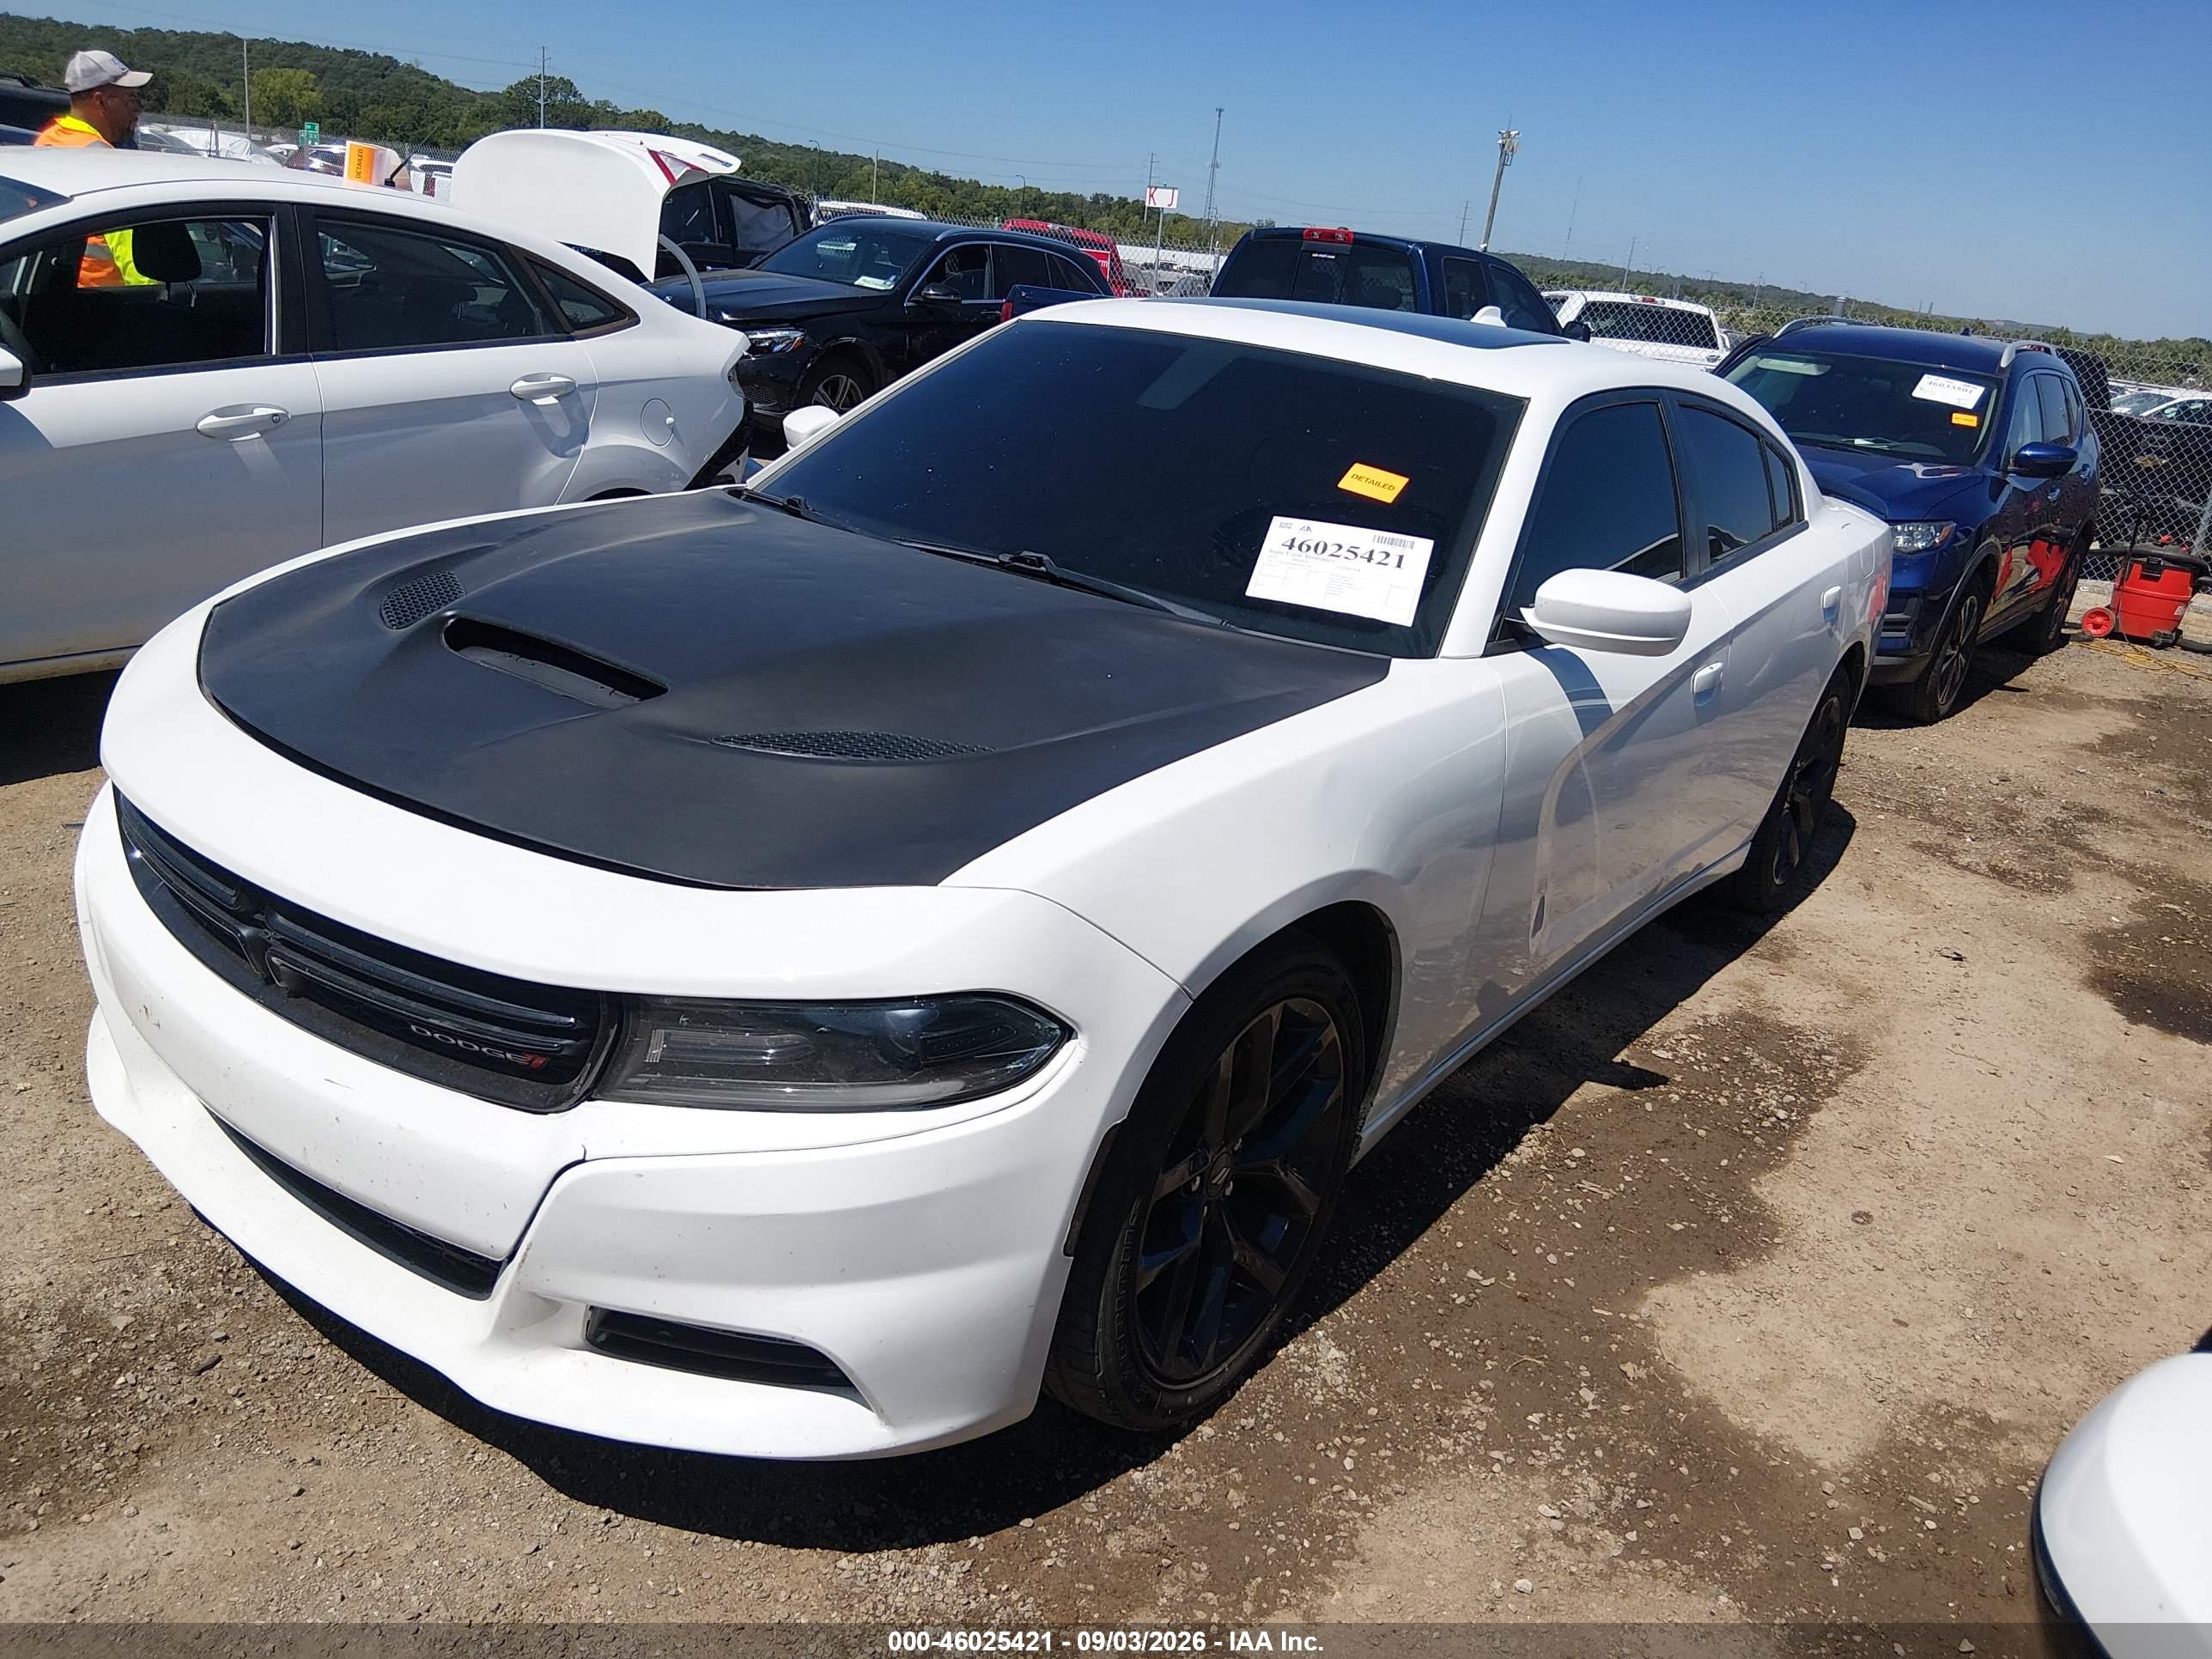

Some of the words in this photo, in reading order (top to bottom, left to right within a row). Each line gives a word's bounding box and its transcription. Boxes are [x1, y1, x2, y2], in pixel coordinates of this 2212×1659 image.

[356, 149, 364, 179] DETAILED
[1147, 186, 1158, 206] K
[1167, 187, 1176, 207] J
[1350, 473, 1395, 491] DETAILED
[1281, 536, 1406, 568] 46025421
[410, 1024, 530, 1065] DODGE
